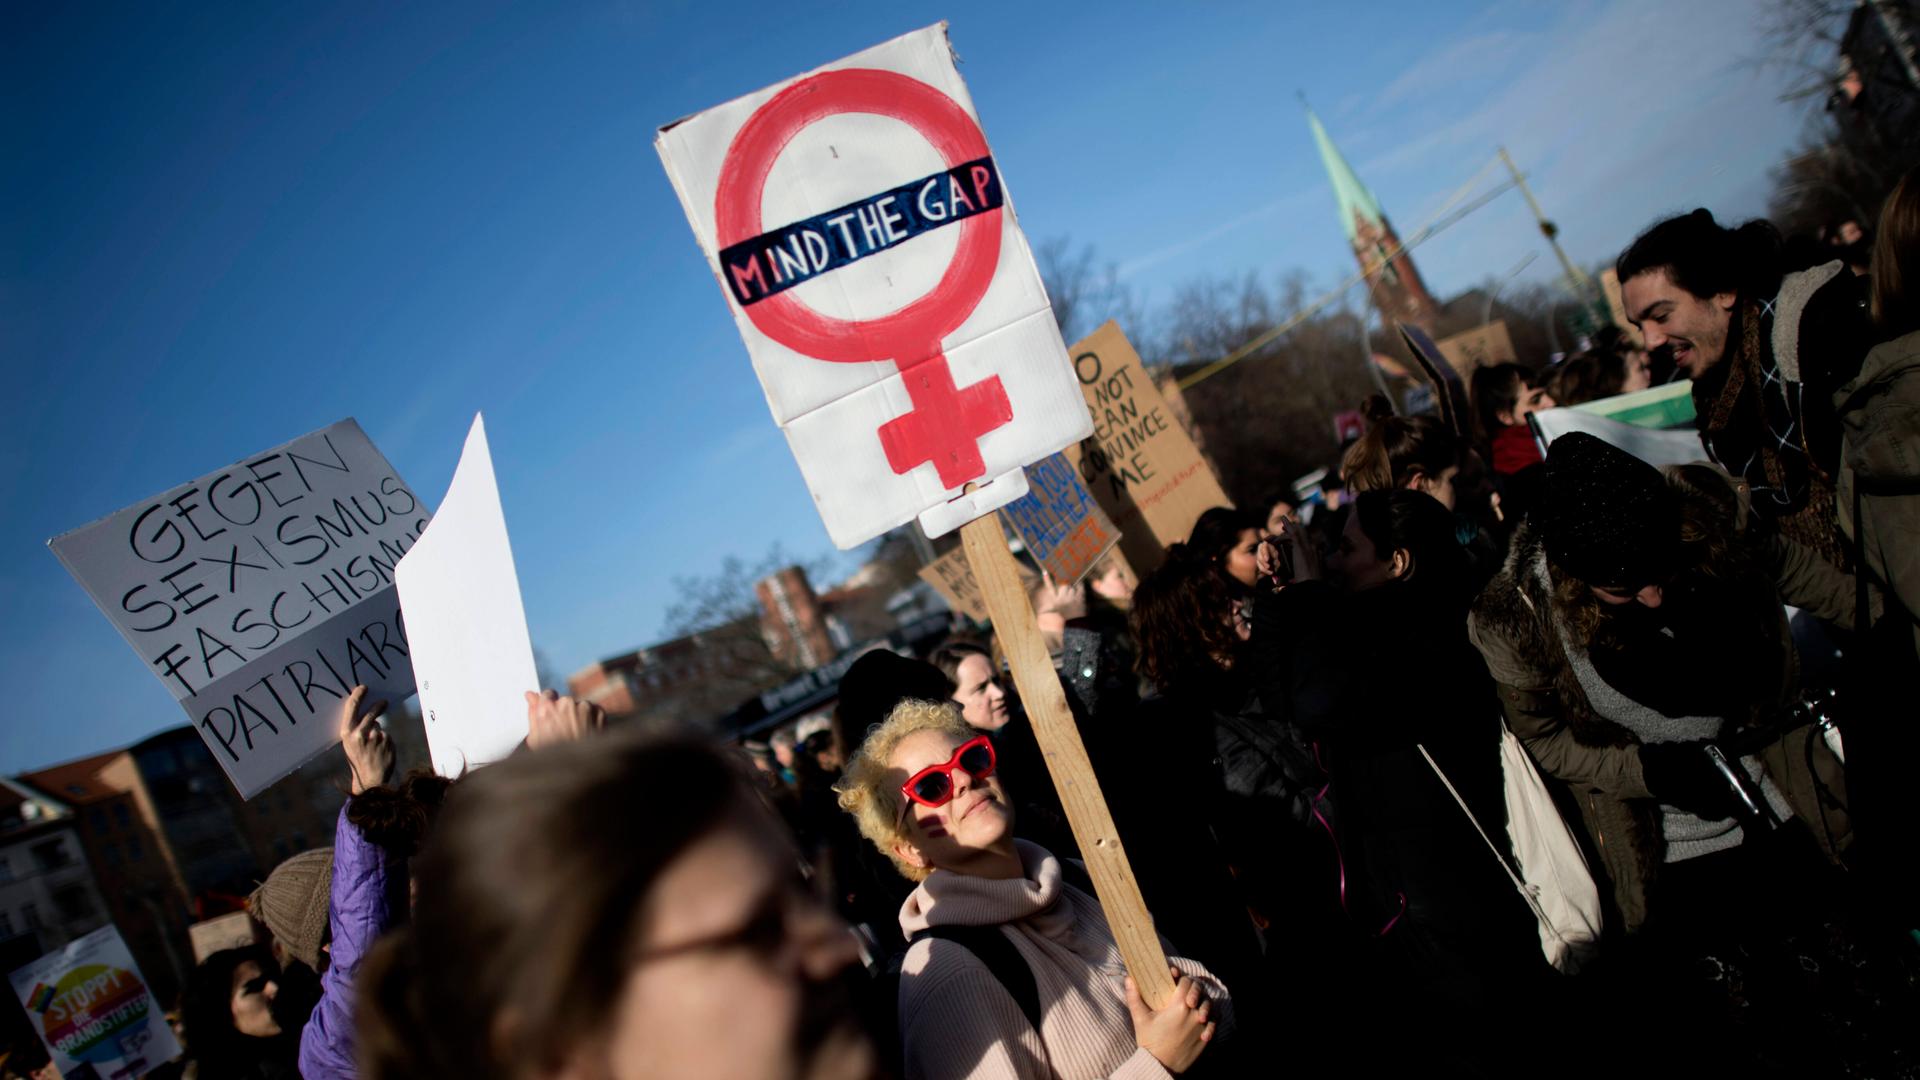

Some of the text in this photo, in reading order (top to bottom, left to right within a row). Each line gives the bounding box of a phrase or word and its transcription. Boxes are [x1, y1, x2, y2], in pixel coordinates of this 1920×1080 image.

[730, 166, 991, 300] MIND THE GAP
[1094, 364, 1134, 409] NOT
[1079, 406, 1168, 483] CONVINCE
[1083, 397, 1138, 448] EAN
[130, 434, 350, 563] GEGEN
[1109, 452, 1156, 500] ME
[122, 477, 415, 632] SEXISMUS
[50, 967, 122, 1021] STOPPT
